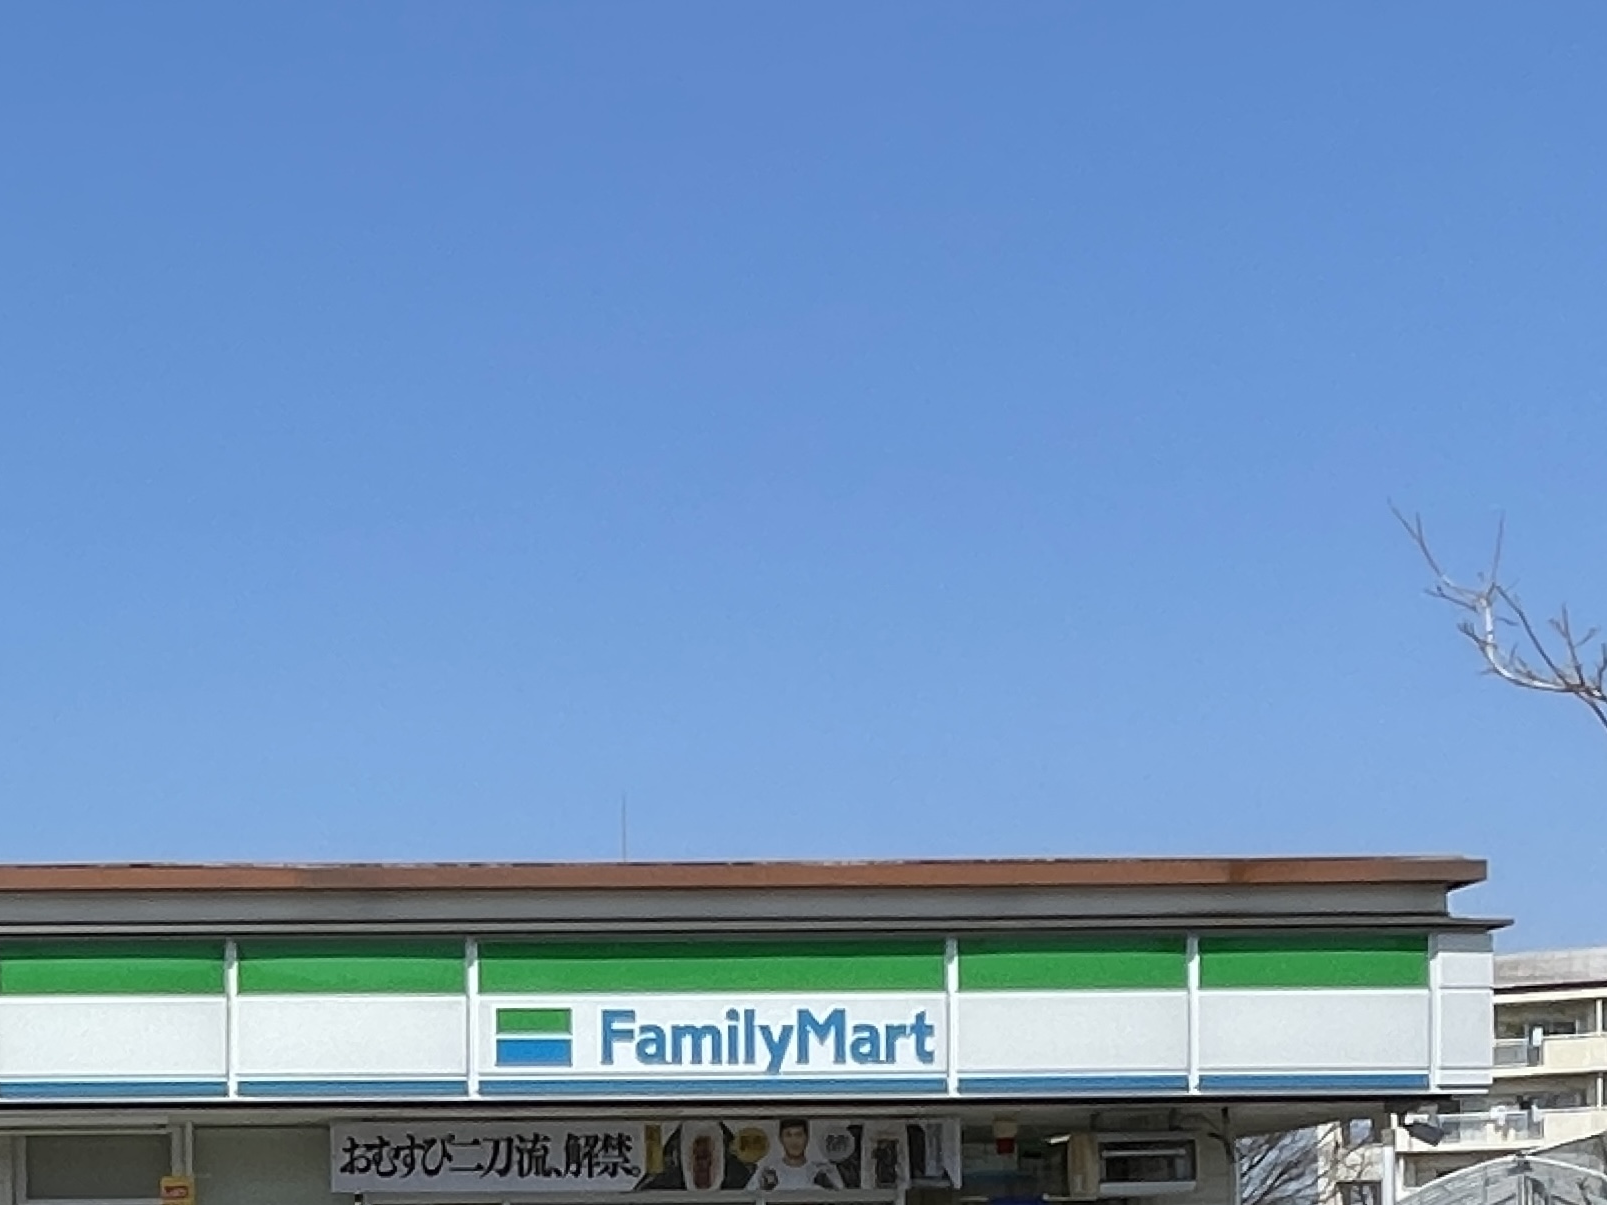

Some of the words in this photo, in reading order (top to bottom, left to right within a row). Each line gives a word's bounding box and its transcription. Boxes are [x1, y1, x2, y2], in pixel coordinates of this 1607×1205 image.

[600, 1008, 935, 1074] FamilyMart
[339, 1132, 641, 1179] おむすび二刀流、解禁。
